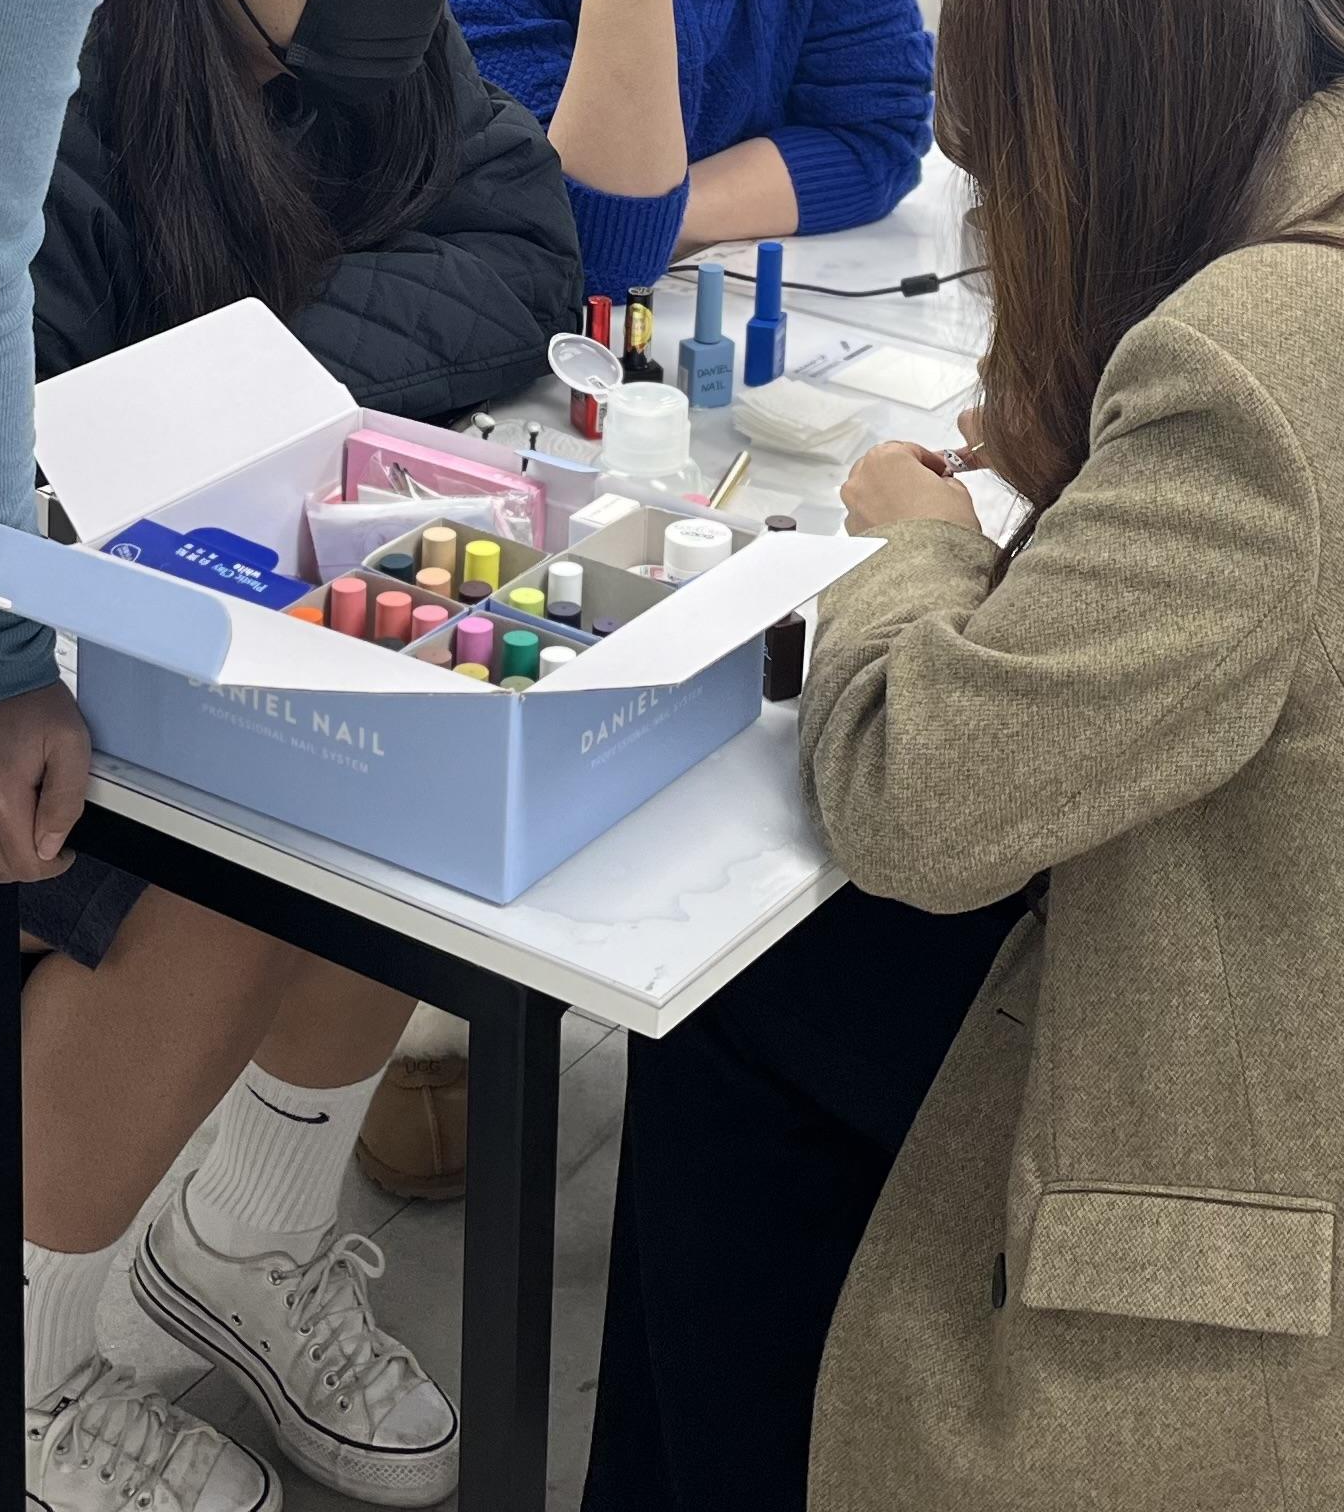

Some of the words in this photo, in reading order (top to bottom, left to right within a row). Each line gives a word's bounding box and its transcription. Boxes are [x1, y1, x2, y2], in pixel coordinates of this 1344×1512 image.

[697, 364, 733, 378] DANIEL
[701, 380, 725, 393] NAIL
[188, 675, 297, 725] ANIEL
[313, 711, 385, 757] NAIL
[202, 702, 287, 744] PROFESSIONAL
[290, 735, 316, 755] NAIL
[322, 746, 369, 774] SYSTEM
[581, 688, 659, 755] DANIEL
